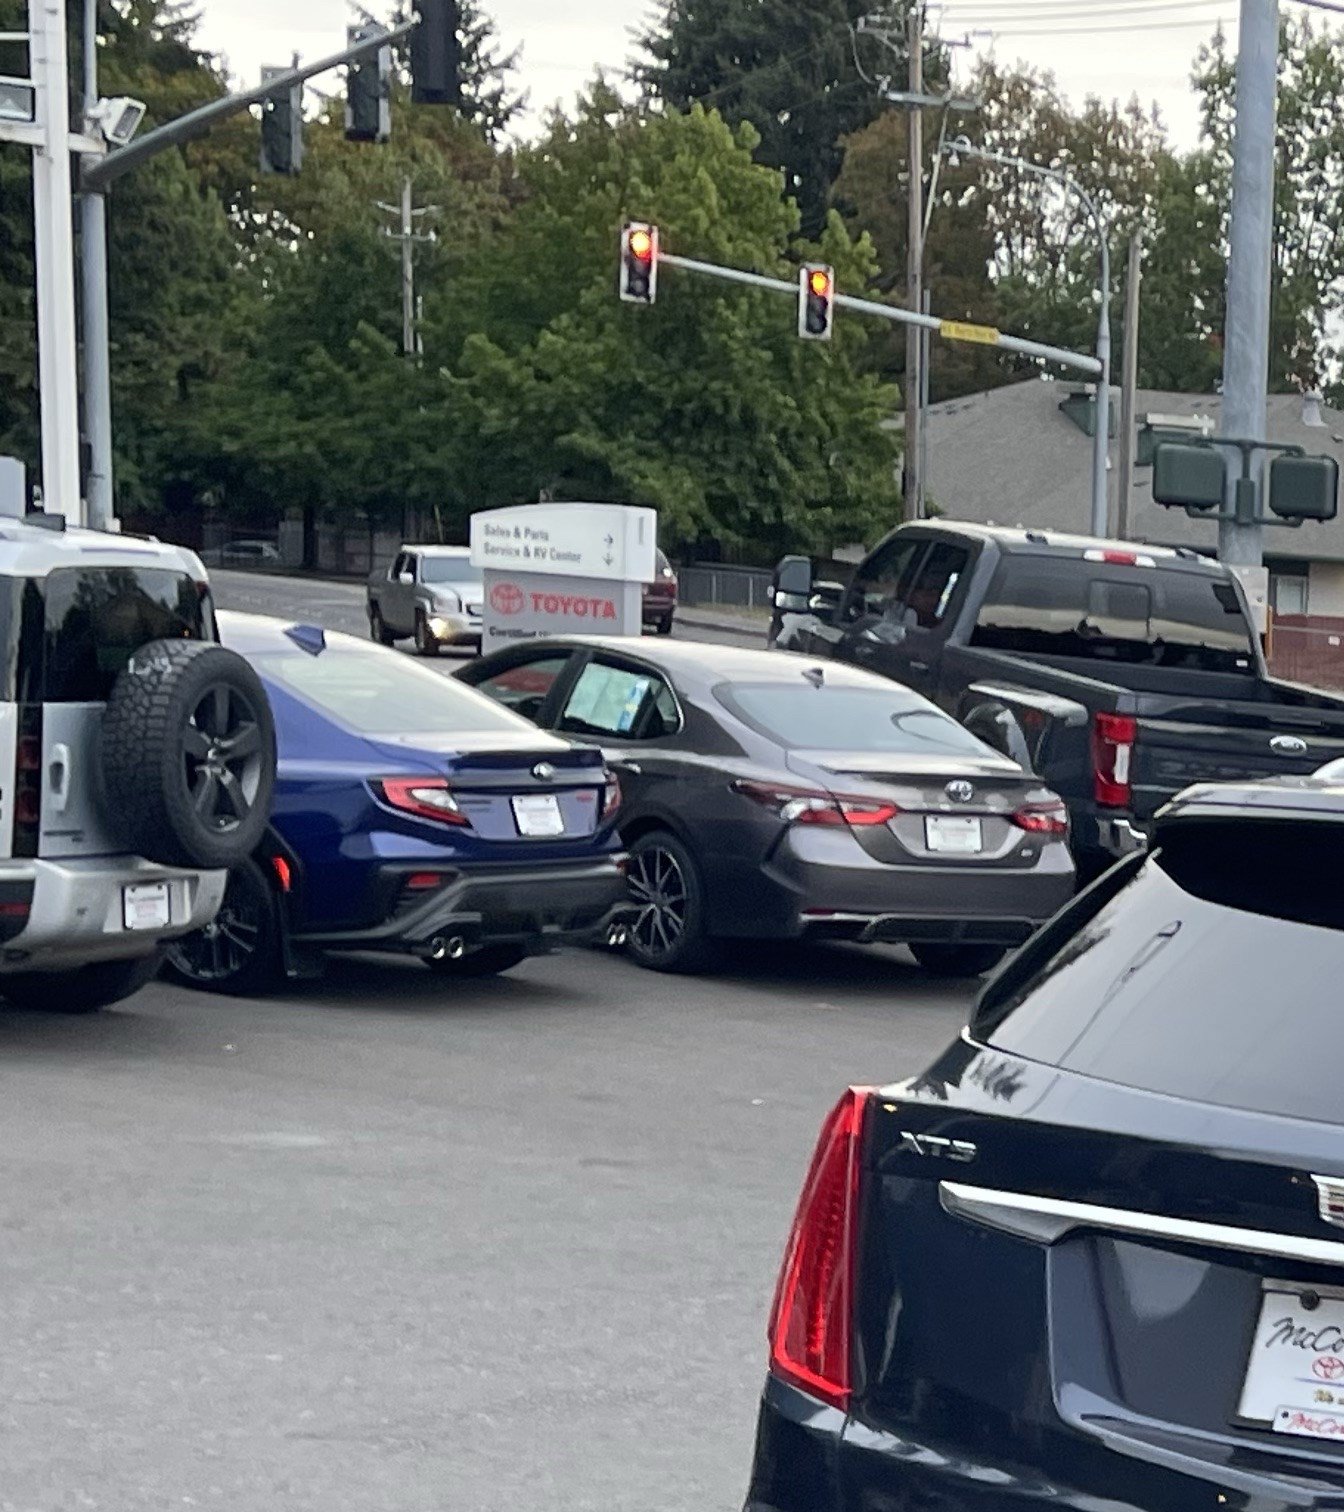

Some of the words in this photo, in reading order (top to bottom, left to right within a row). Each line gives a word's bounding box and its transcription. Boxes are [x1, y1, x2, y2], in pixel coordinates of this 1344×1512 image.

[484, 523, 512, 538] Sales
[524, 526, 550, 541] Parts
[484, 541, 521, 556] Service
[529, 592, 618, 620] TOYOTA
